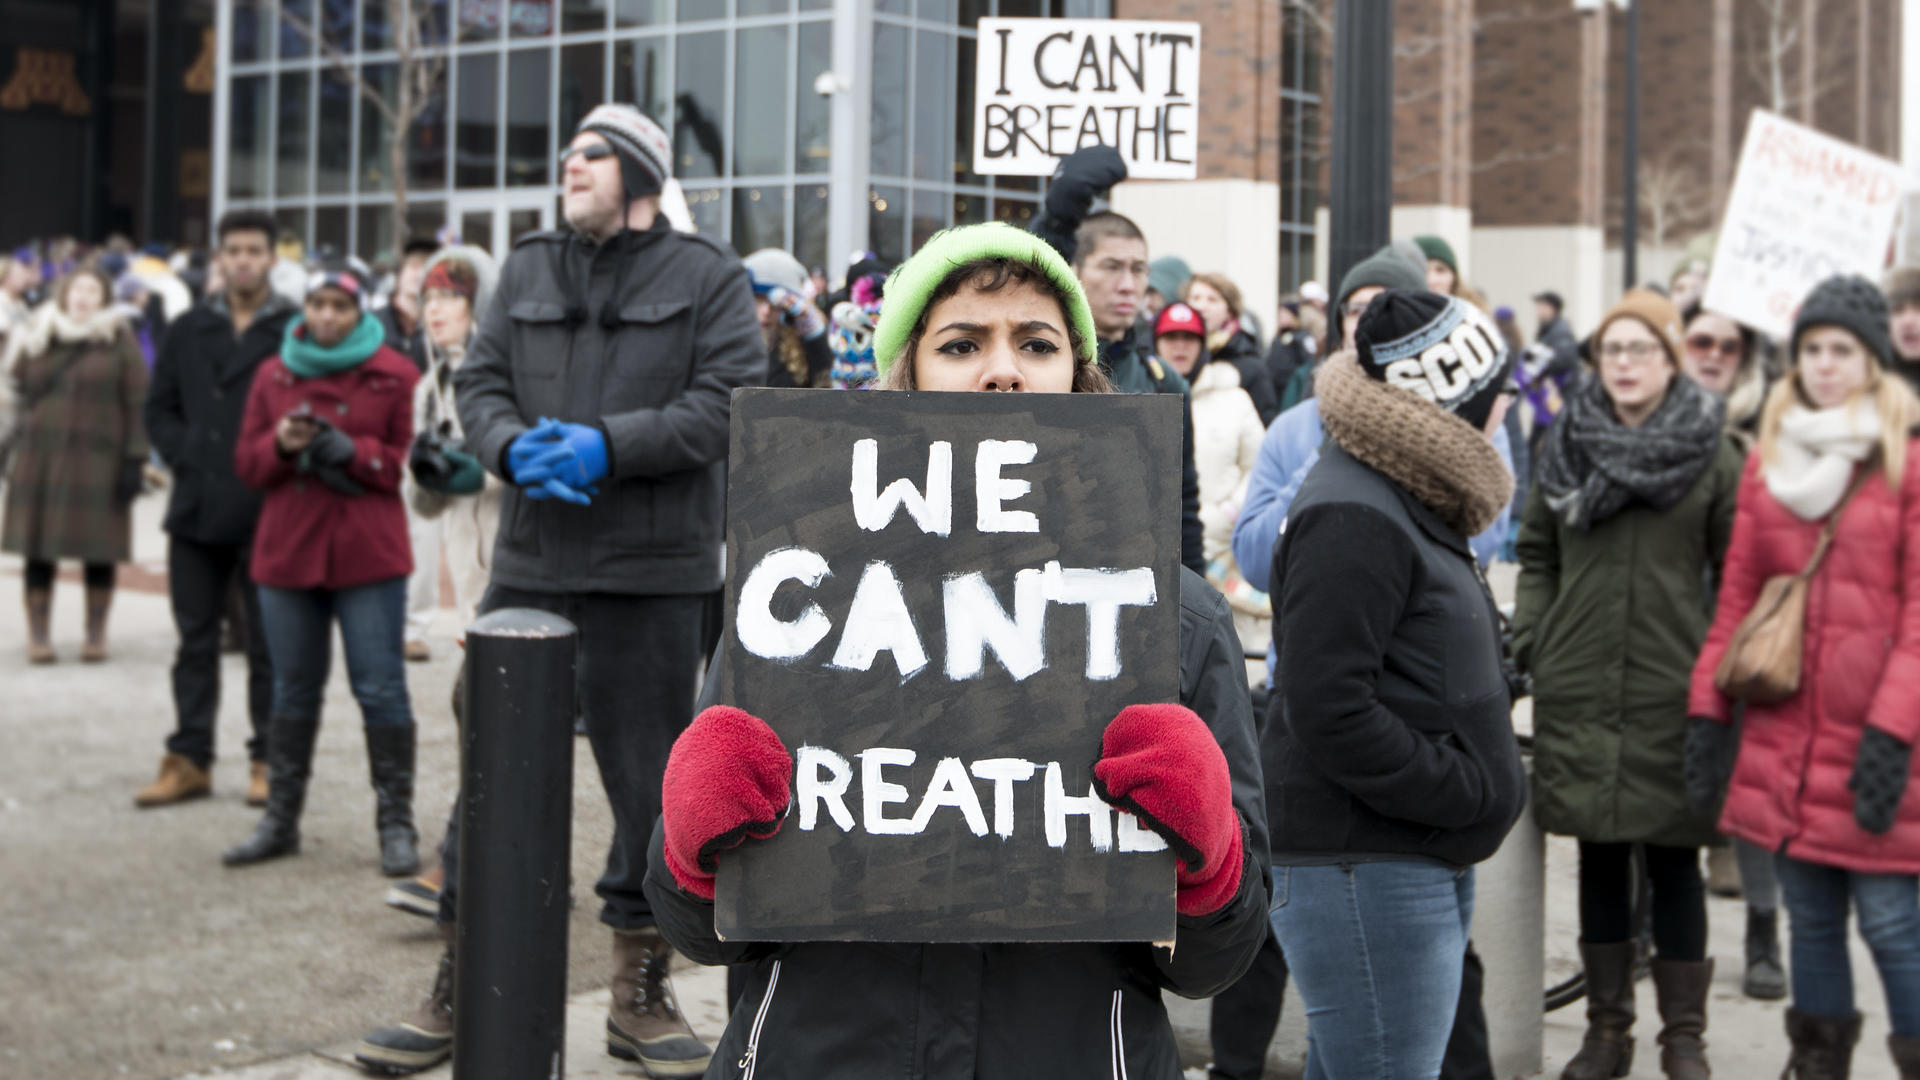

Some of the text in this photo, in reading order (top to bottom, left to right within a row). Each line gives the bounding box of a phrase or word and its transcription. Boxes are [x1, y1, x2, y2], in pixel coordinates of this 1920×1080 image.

[995, 29, 1194, 97] I CAN'T
[983, 103, 1193, 165] BREATHE
[849, 438, 1040, 539] WE
[783, 741, 1169, 854] REATH
